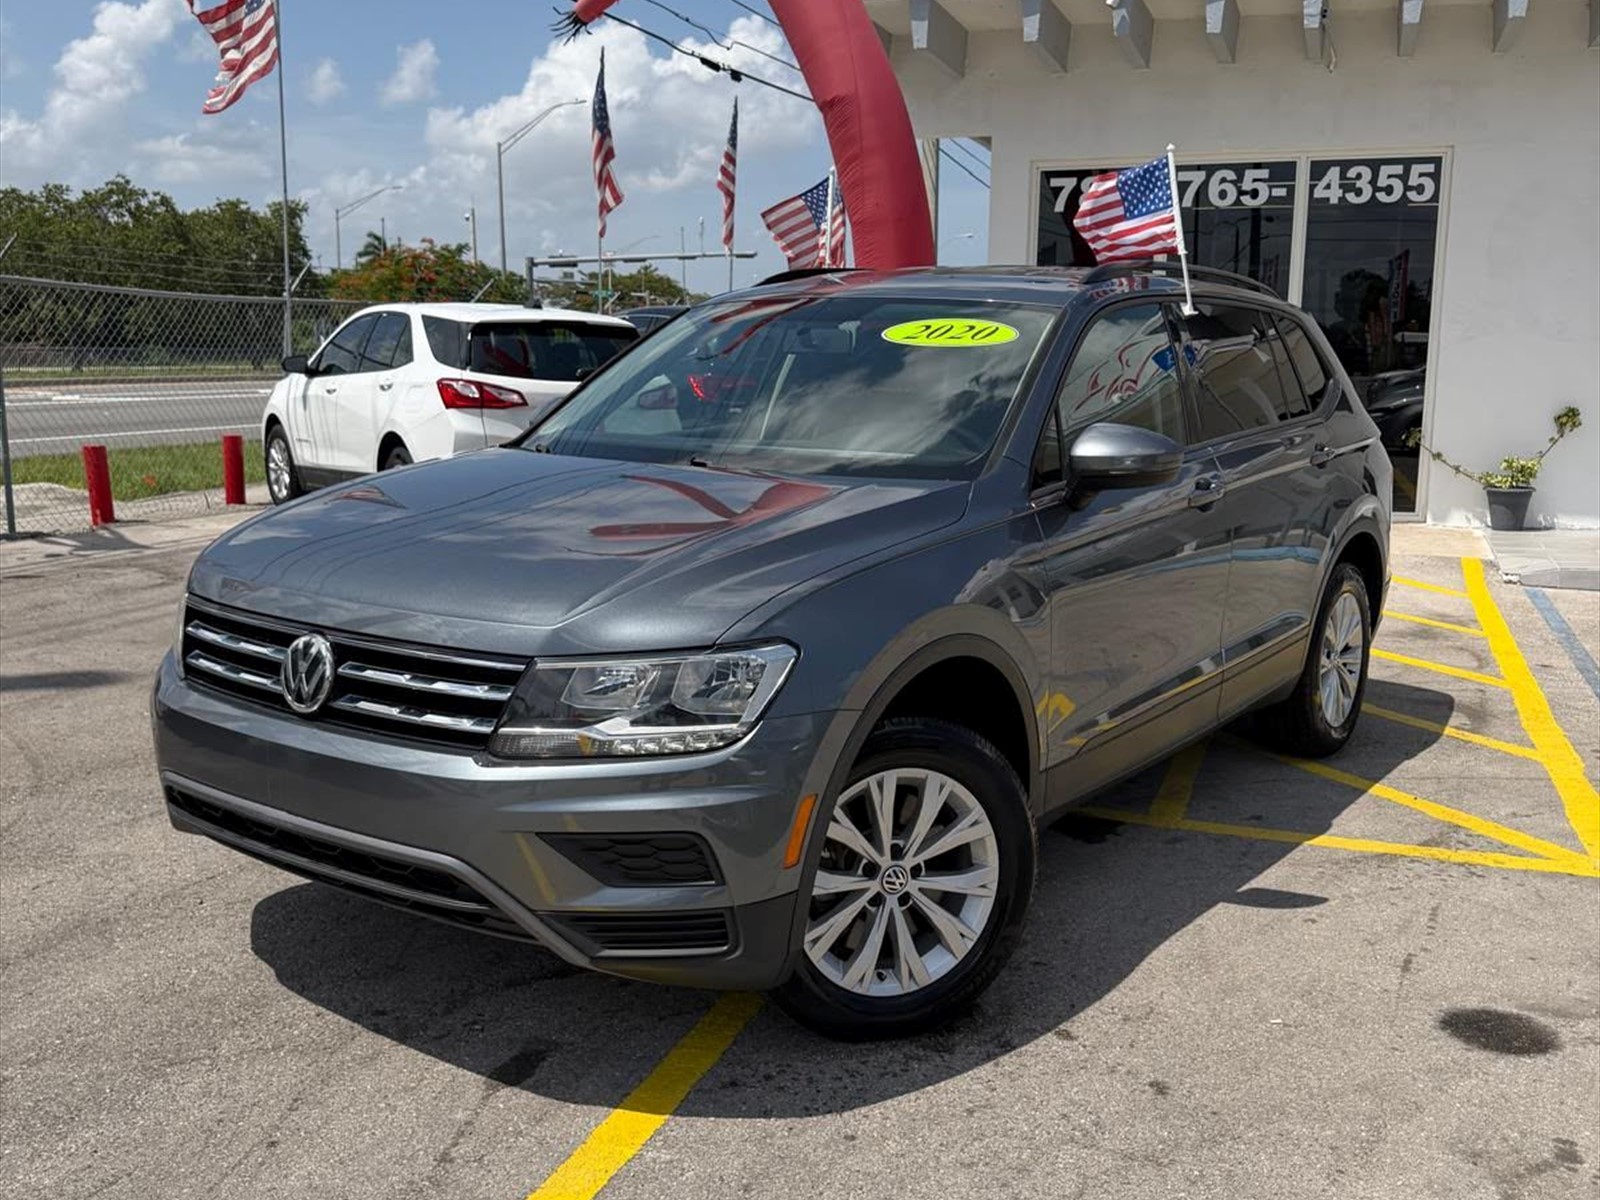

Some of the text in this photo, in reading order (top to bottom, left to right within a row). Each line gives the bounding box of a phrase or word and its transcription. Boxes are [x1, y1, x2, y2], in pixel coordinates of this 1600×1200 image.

[1177, 168, 1288, 208] 765-
[1313, 163, 1435, 204] 4355
[903, 324, 1000, 341] 2020
